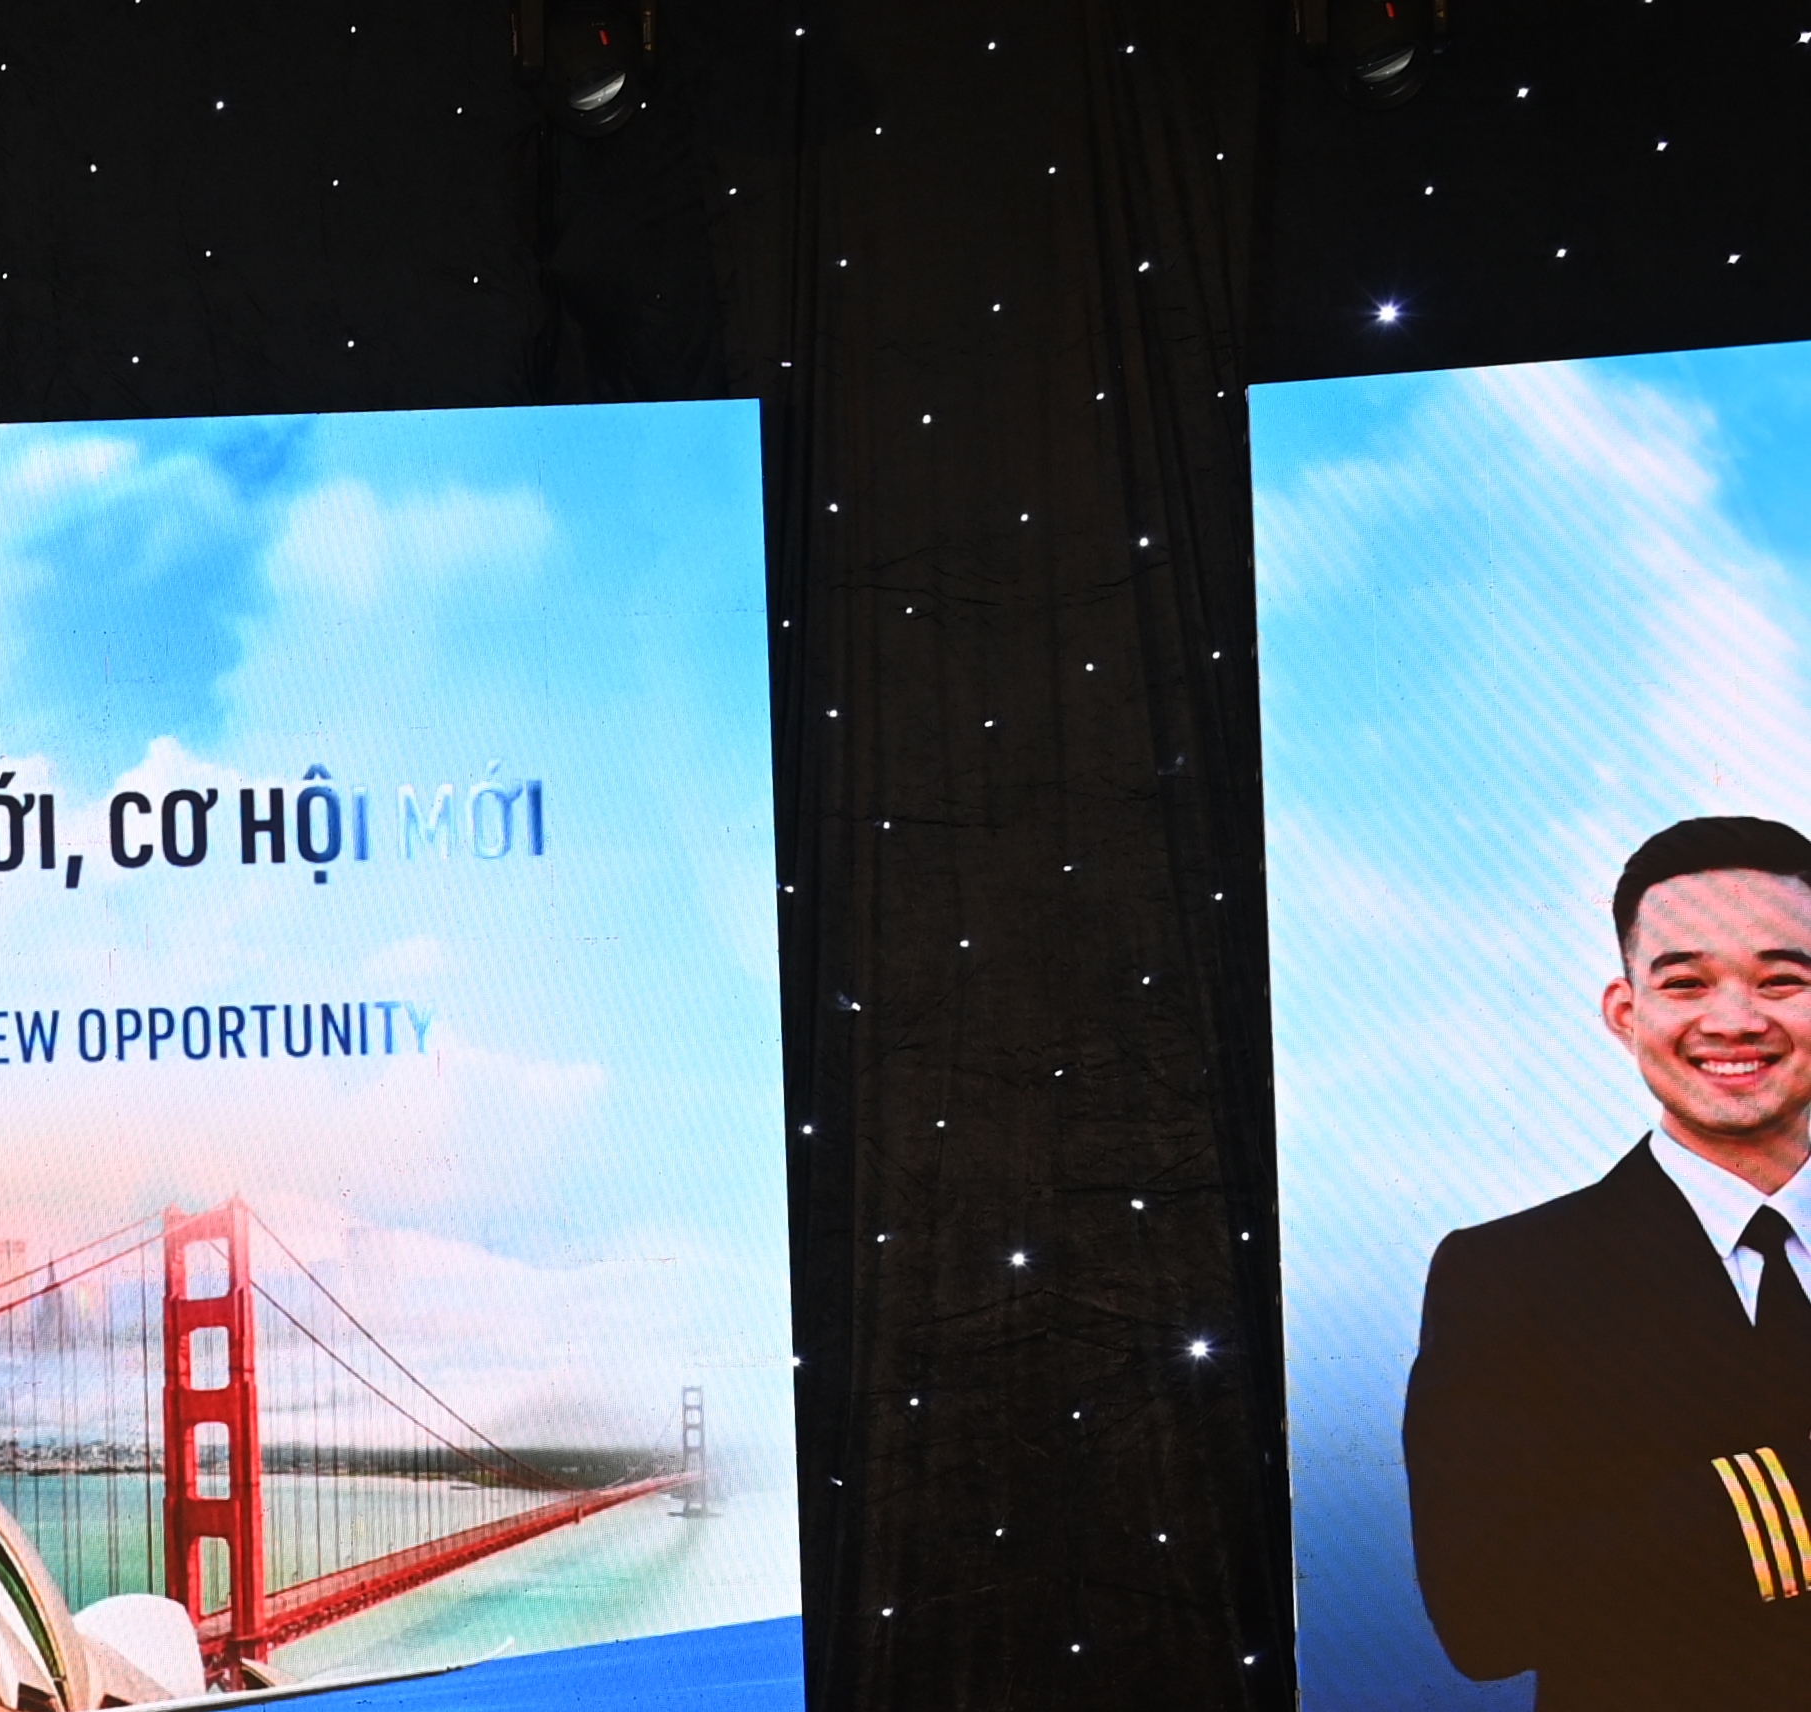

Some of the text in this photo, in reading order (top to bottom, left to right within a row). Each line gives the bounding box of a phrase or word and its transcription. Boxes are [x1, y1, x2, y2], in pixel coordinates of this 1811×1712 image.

[109, 788, 218, 869] CƠ
[240, 764, 370, 886] HỘI
[396, 759, 546, 862] MỚI
[77, 1001, 434, 1063] OPPORTUNITY
